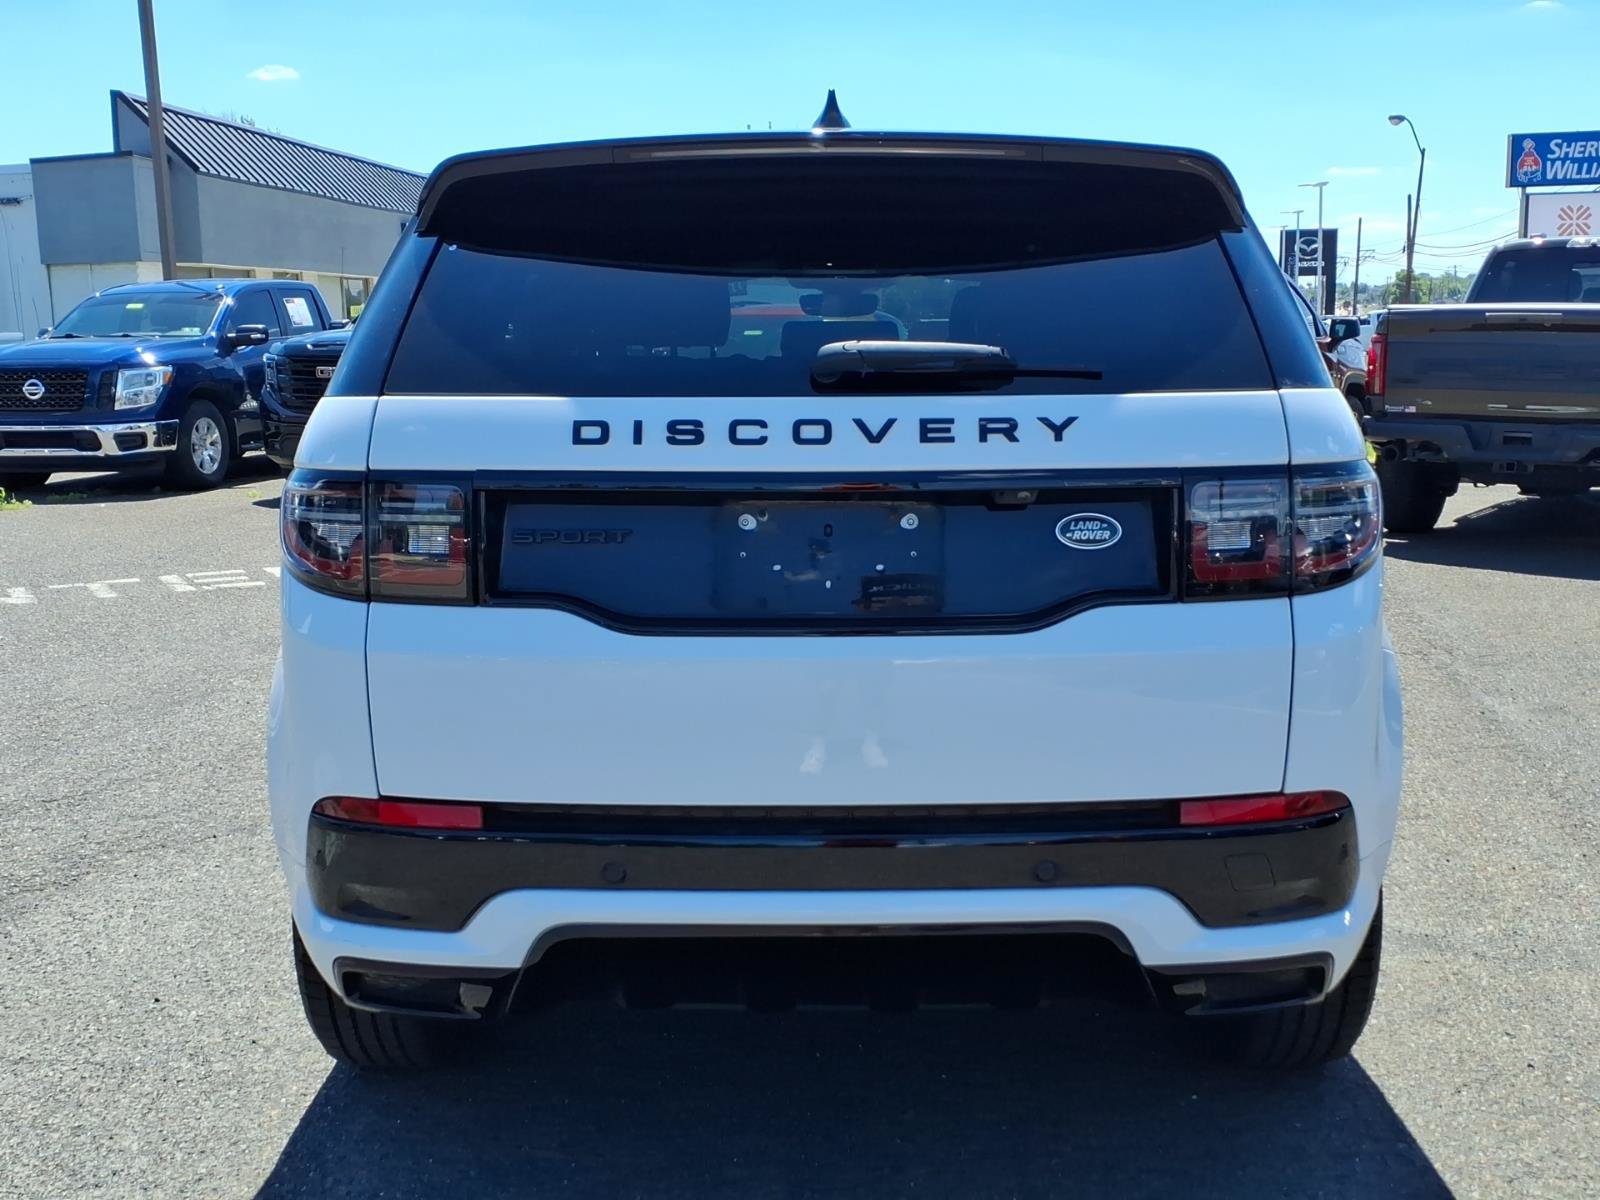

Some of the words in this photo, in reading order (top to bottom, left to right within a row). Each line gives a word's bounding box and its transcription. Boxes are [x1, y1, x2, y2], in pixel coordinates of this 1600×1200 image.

[1547, 139, 1600, 159] SHER
[572, 416, 1079, 446] DISCOVERY
[1070, 521, 1101, 530] LAND
[512, 528, 633, 544] SPORT
[1072, 530, 1111, 540] ROVER
